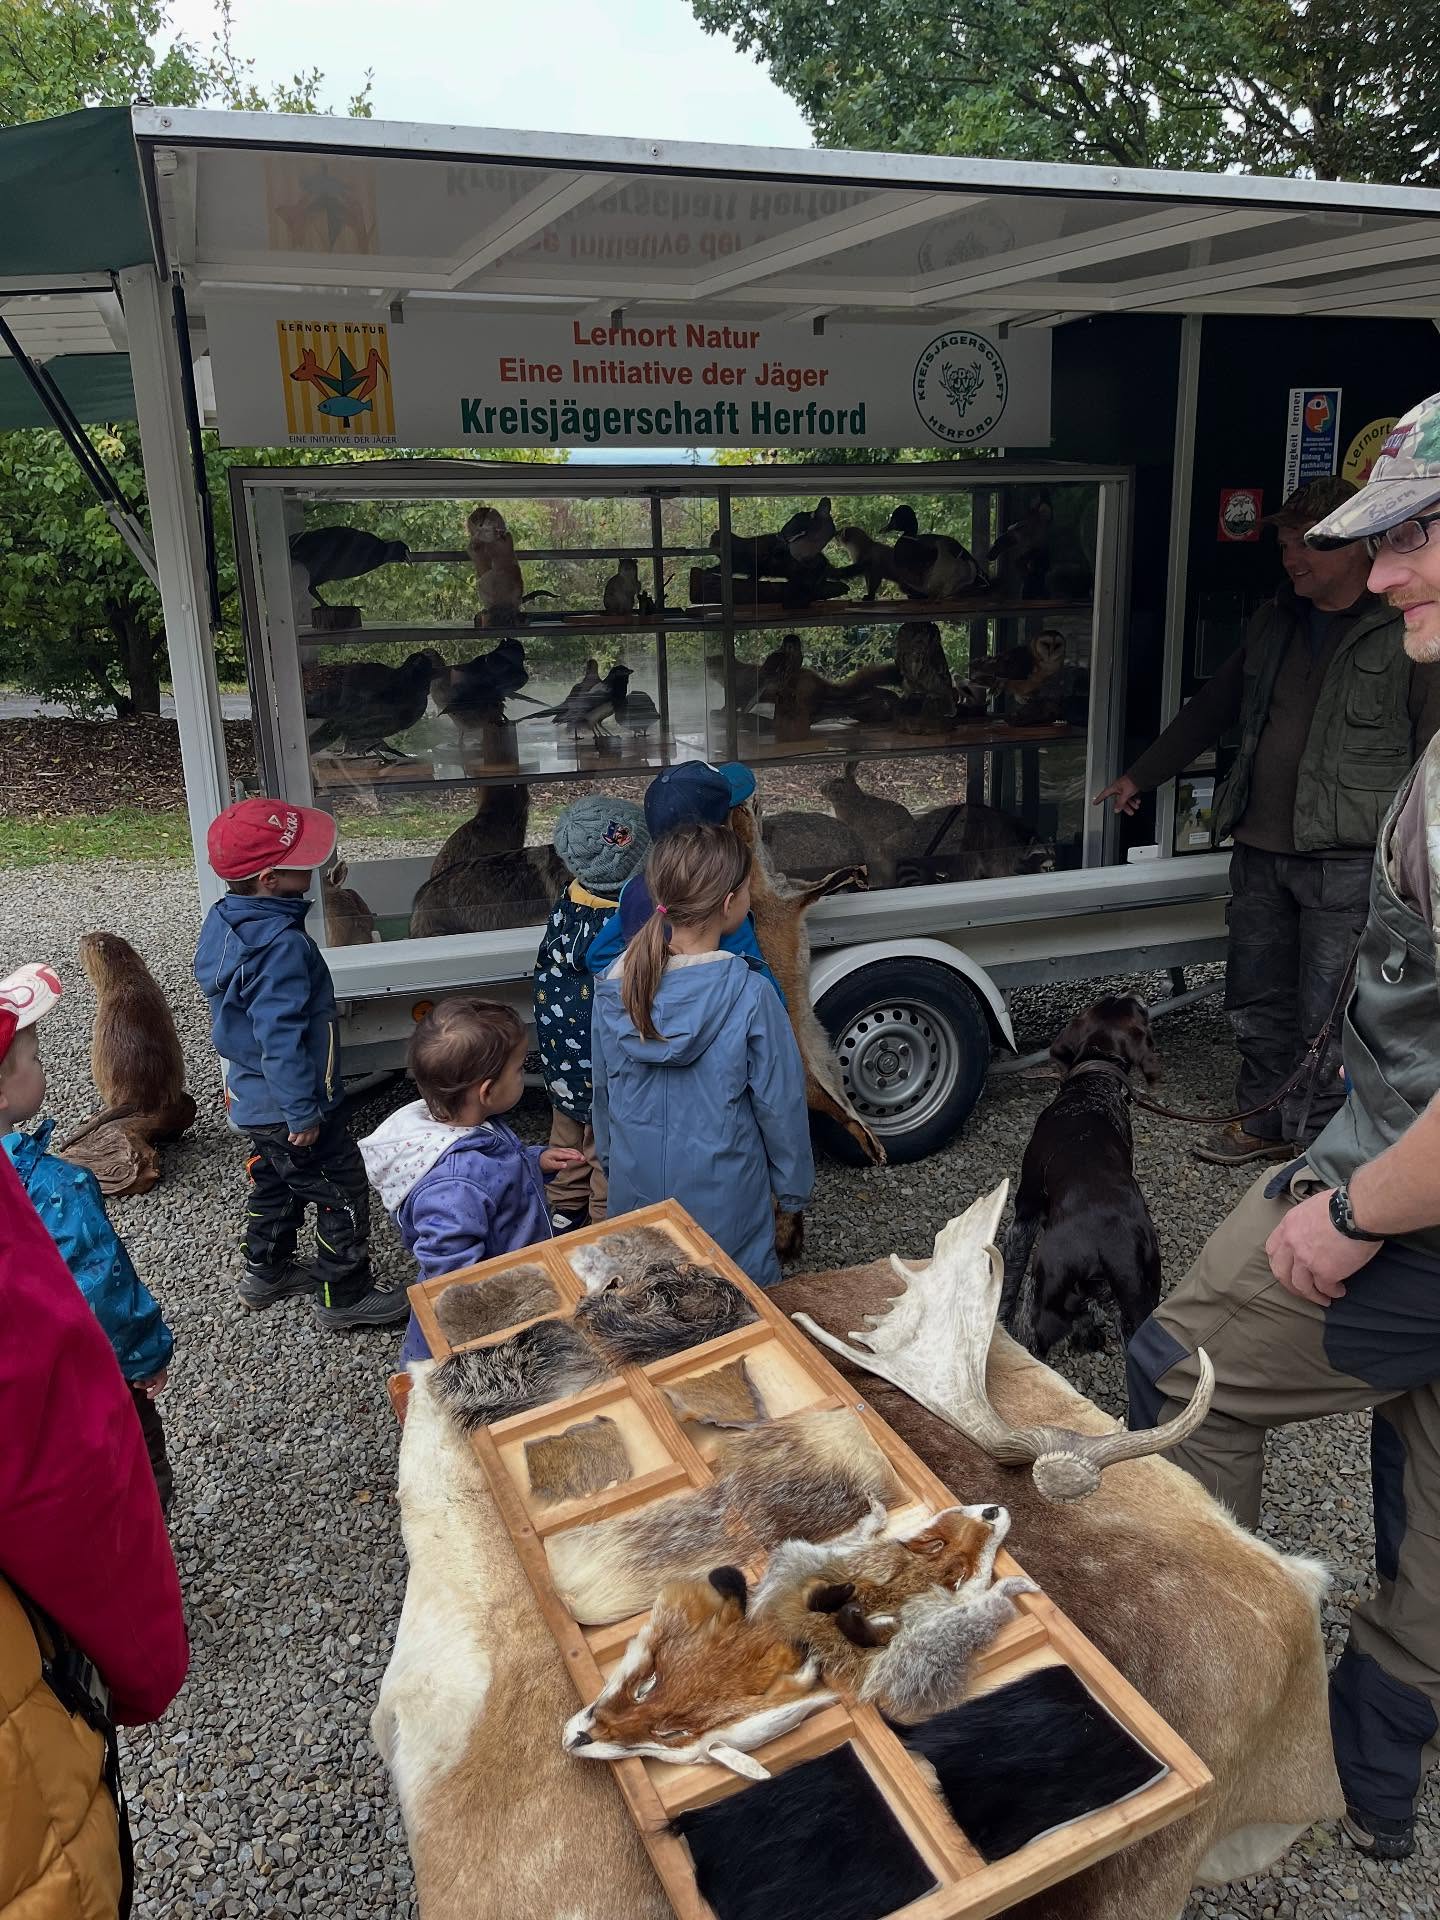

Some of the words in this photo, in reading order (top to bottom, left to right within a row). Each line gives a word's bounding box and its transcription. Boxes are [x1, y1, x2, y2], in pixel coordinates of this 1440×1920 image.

[281, 323, 337, 333] LERNORT
[345, 325, 385, 335] NATUR
[572, 320, 677, 347] Lernort
[686, 323, 760, 349] Natur
[499, 357, 563, 383] Eine
[572, 359, 693, 385] Initiative
[702, 361, 747, 386] der
[754, 362, 829, 393] Jäger
[917, 336, 1004, 401] KREISJÄGERSCHAFT
[460, 398, 739, 443] Kreisjägerschaft
[751, 400, 866, 435] Herford
[929, 415, 993, 439] HERFORD
[1290, 391, 1301, 427] lernen
[289, 435, 307, 444] EINE
[310, 435, 351, 444] INITIATIVE
[354, 436, 370, 444] DER
[373, 435, 397, 444] JÄGER
[1346, 422, 1391, 468] Lernort
[279, 811, 298, 847] DEKRA
